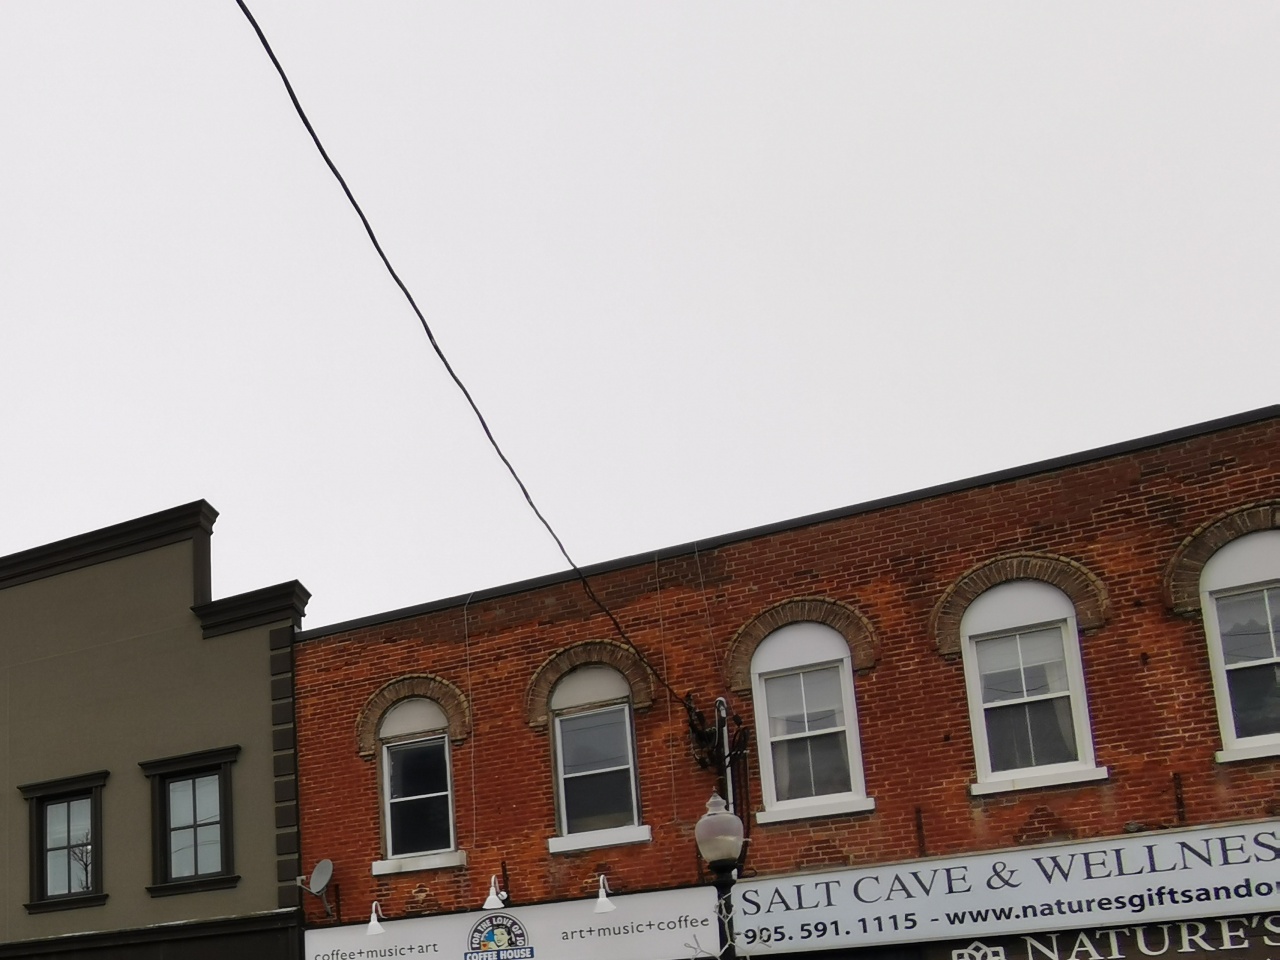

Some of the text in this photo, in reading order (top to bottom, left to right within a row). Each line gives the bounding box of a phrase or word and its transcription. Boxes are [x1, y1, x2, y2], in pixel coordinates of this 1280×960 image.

[742, 880, 841, 917] SALT
[853, 865, 973, 904] CAVE
[986, 861, 1023, 890] &
[472, 932, 481, 948] FOR
[477, 919, 493, 931] THE
[492, 917, 513, 927] LOVE
[511, 925, 522, 935] OF
[561, 914, 710, 941] art+music+coffee
[500, 948, 531, 960] HOUSE
